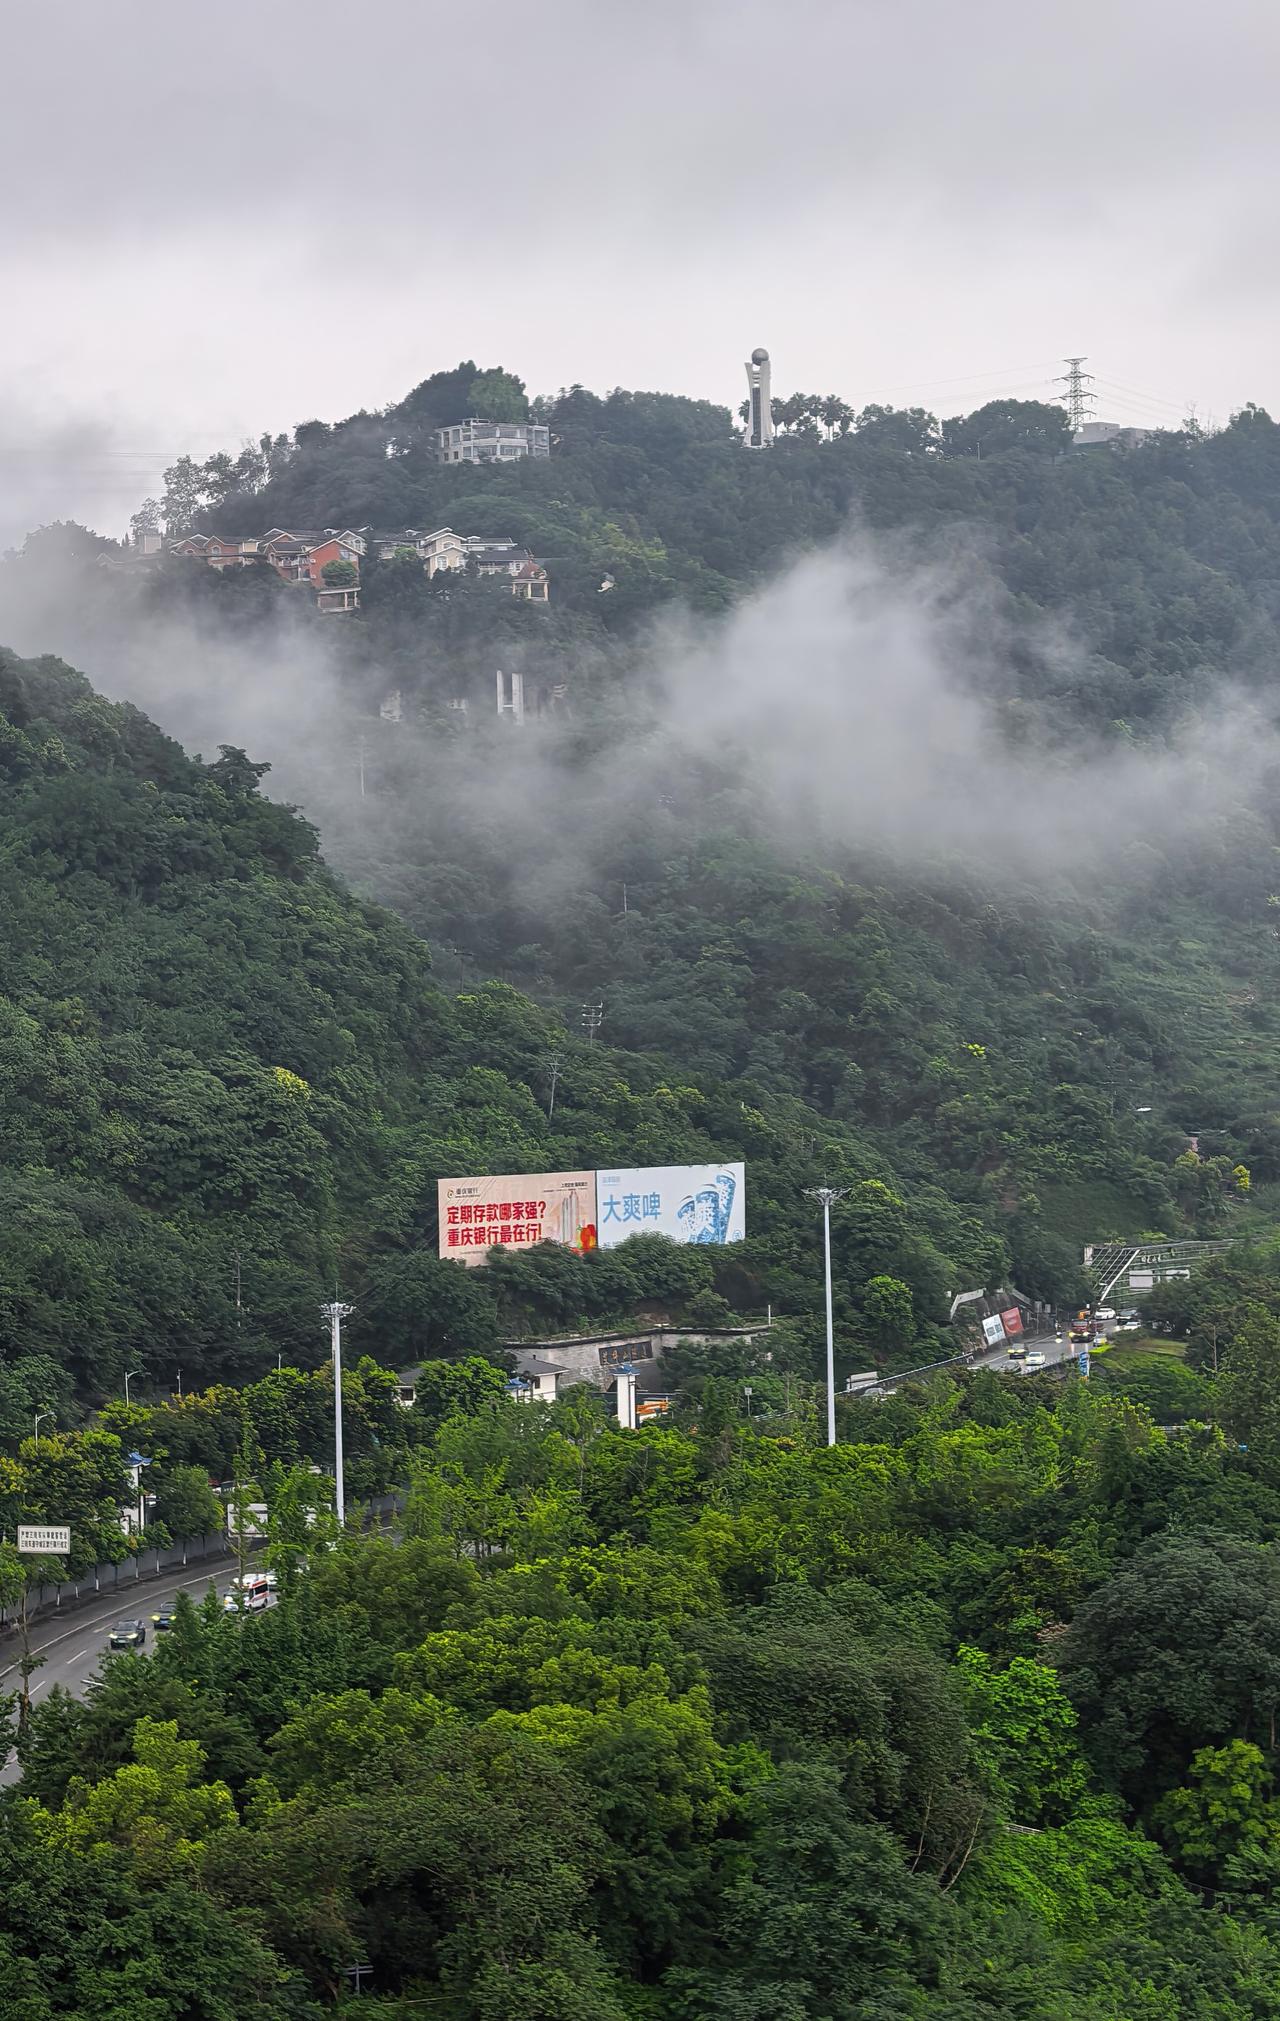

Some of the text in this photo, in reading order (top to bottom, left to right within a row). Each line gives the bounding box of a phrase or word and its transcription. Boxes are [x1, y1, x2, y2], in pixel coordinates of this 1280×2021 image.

[446, 1201, 547, 1225] 定期存款哪家强?
[602, 1191, 661, 1223] 大爽啤
[447, 1223, 543, 1247] 重庆银行最在行!
